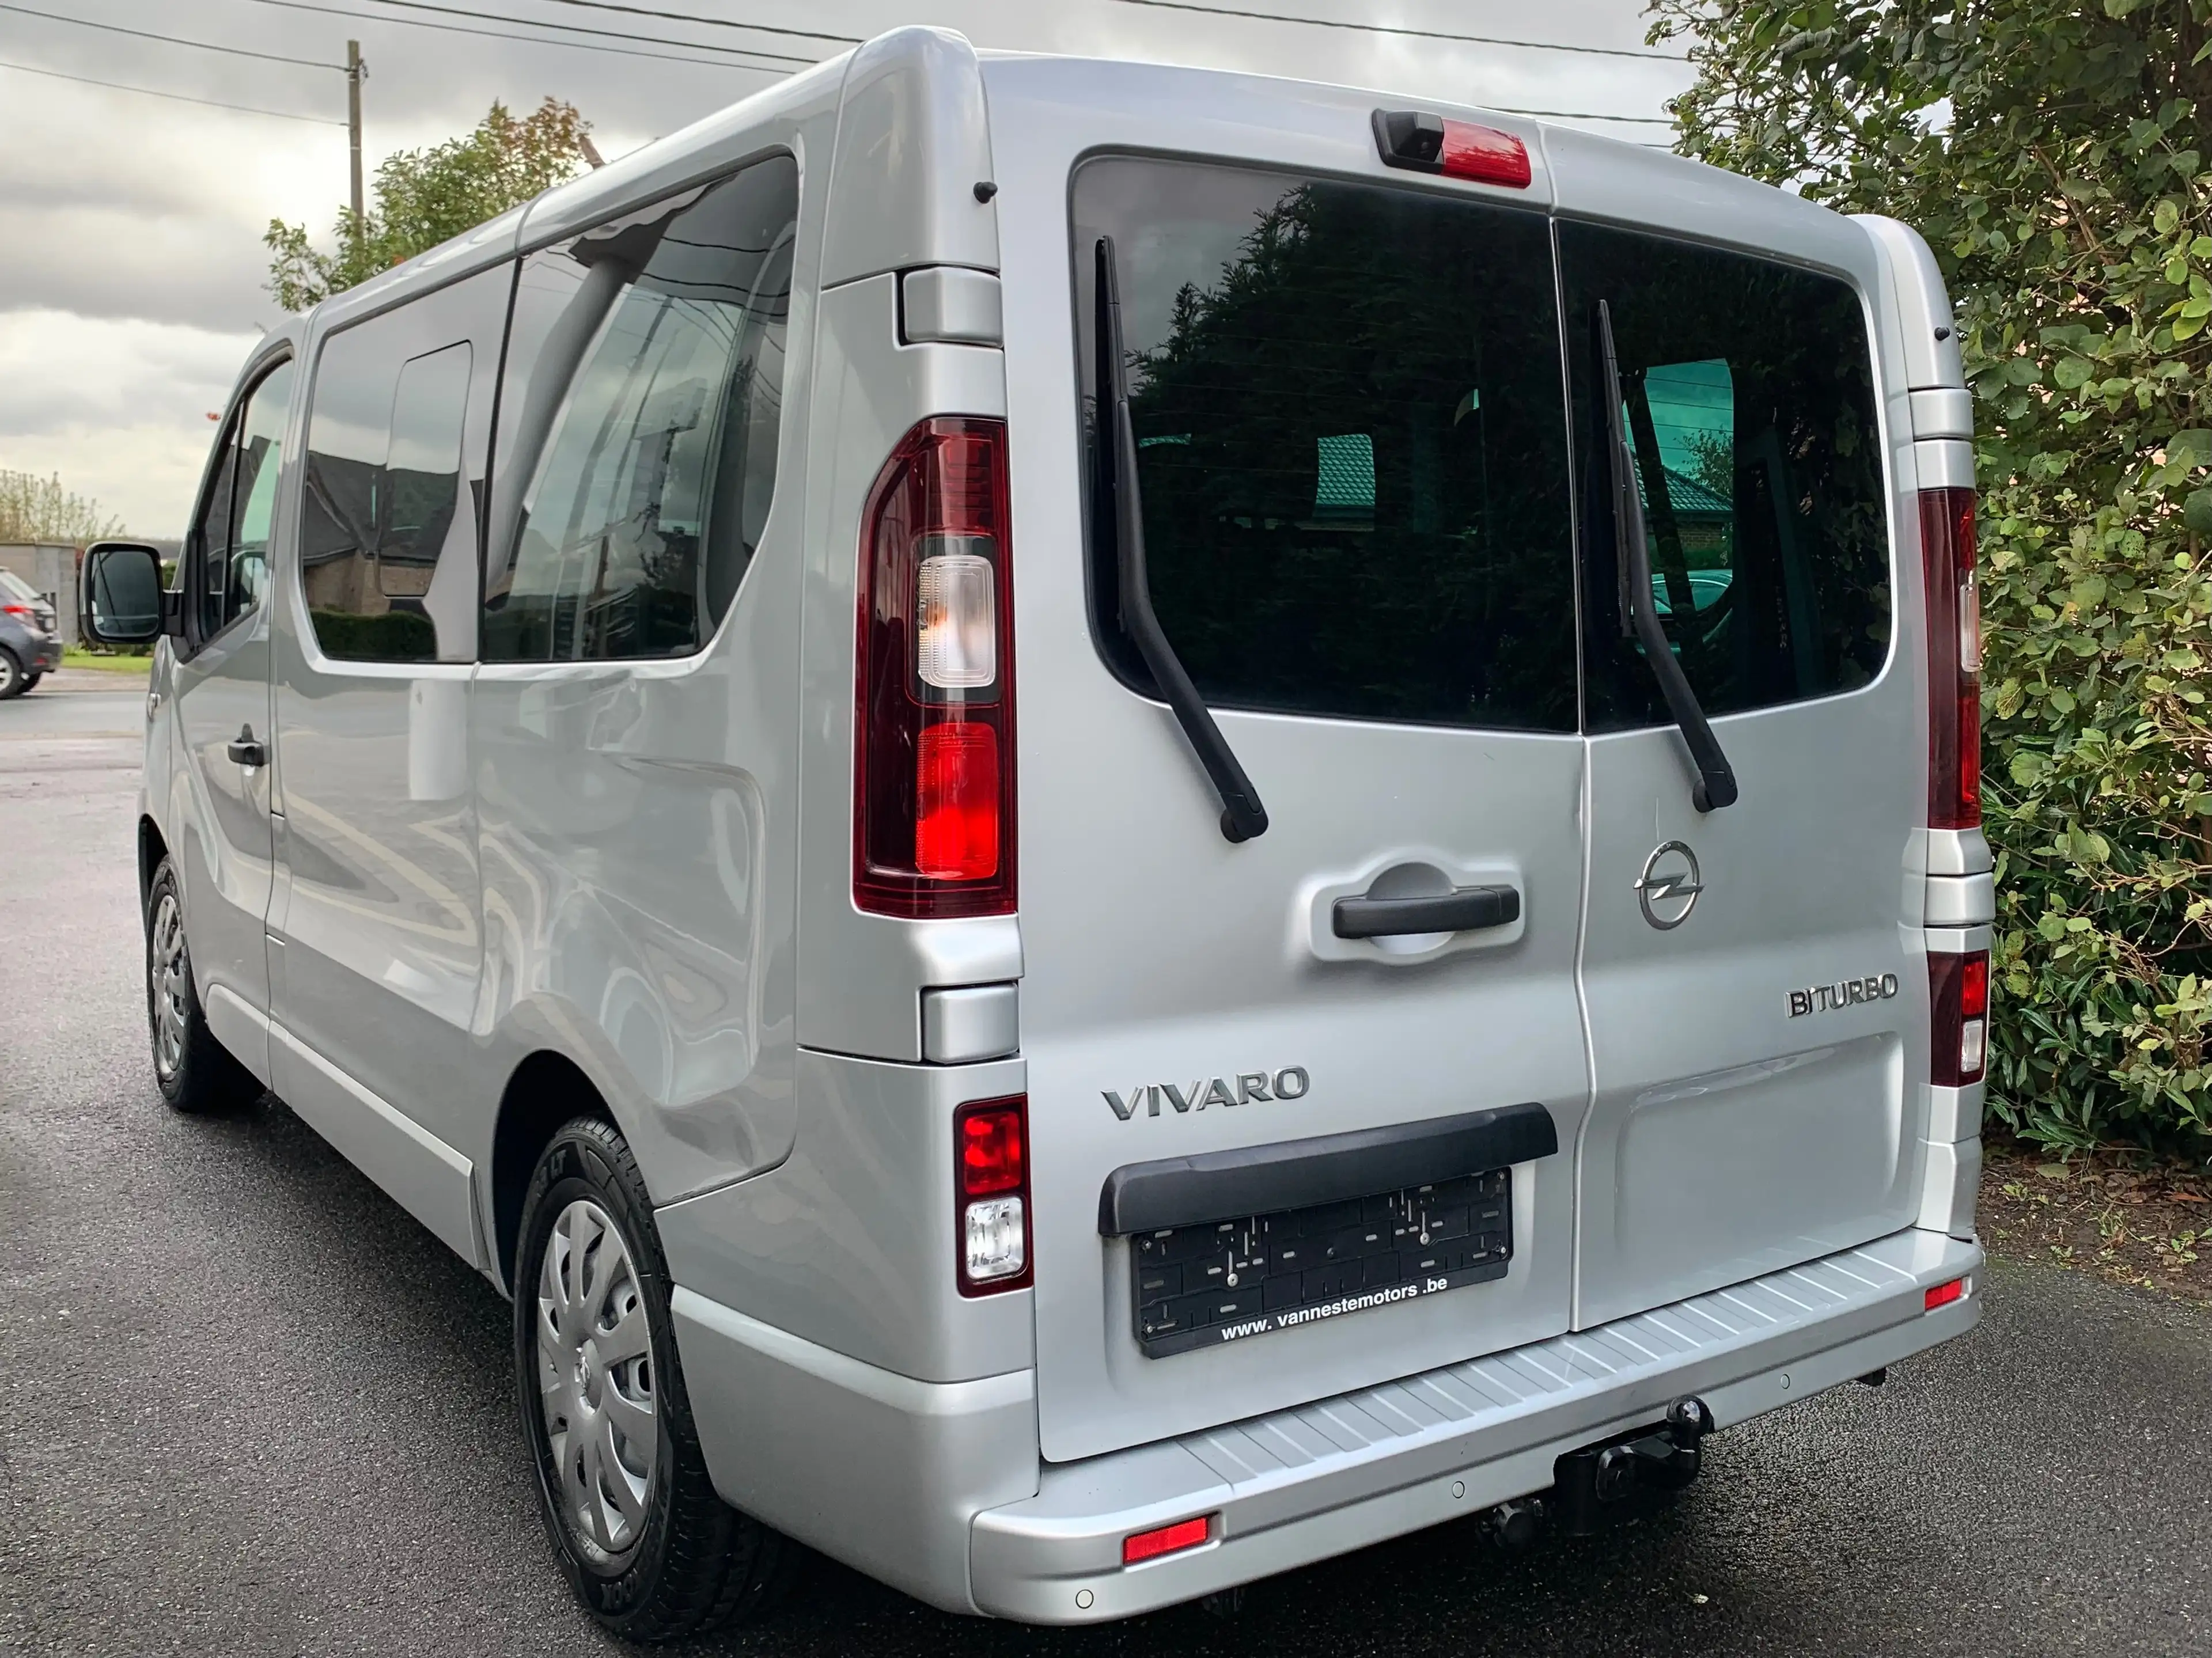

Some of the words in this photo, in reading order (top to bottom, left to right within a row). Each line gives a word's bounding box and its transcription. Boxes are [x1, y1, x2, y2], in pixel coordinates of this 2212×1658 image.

[1786, 973, 1899, 1018] BITURBO
[1100, 1065, 1310, 1121] VIVARO
[1277, 1283, 1418, 1327] vannestemotors
